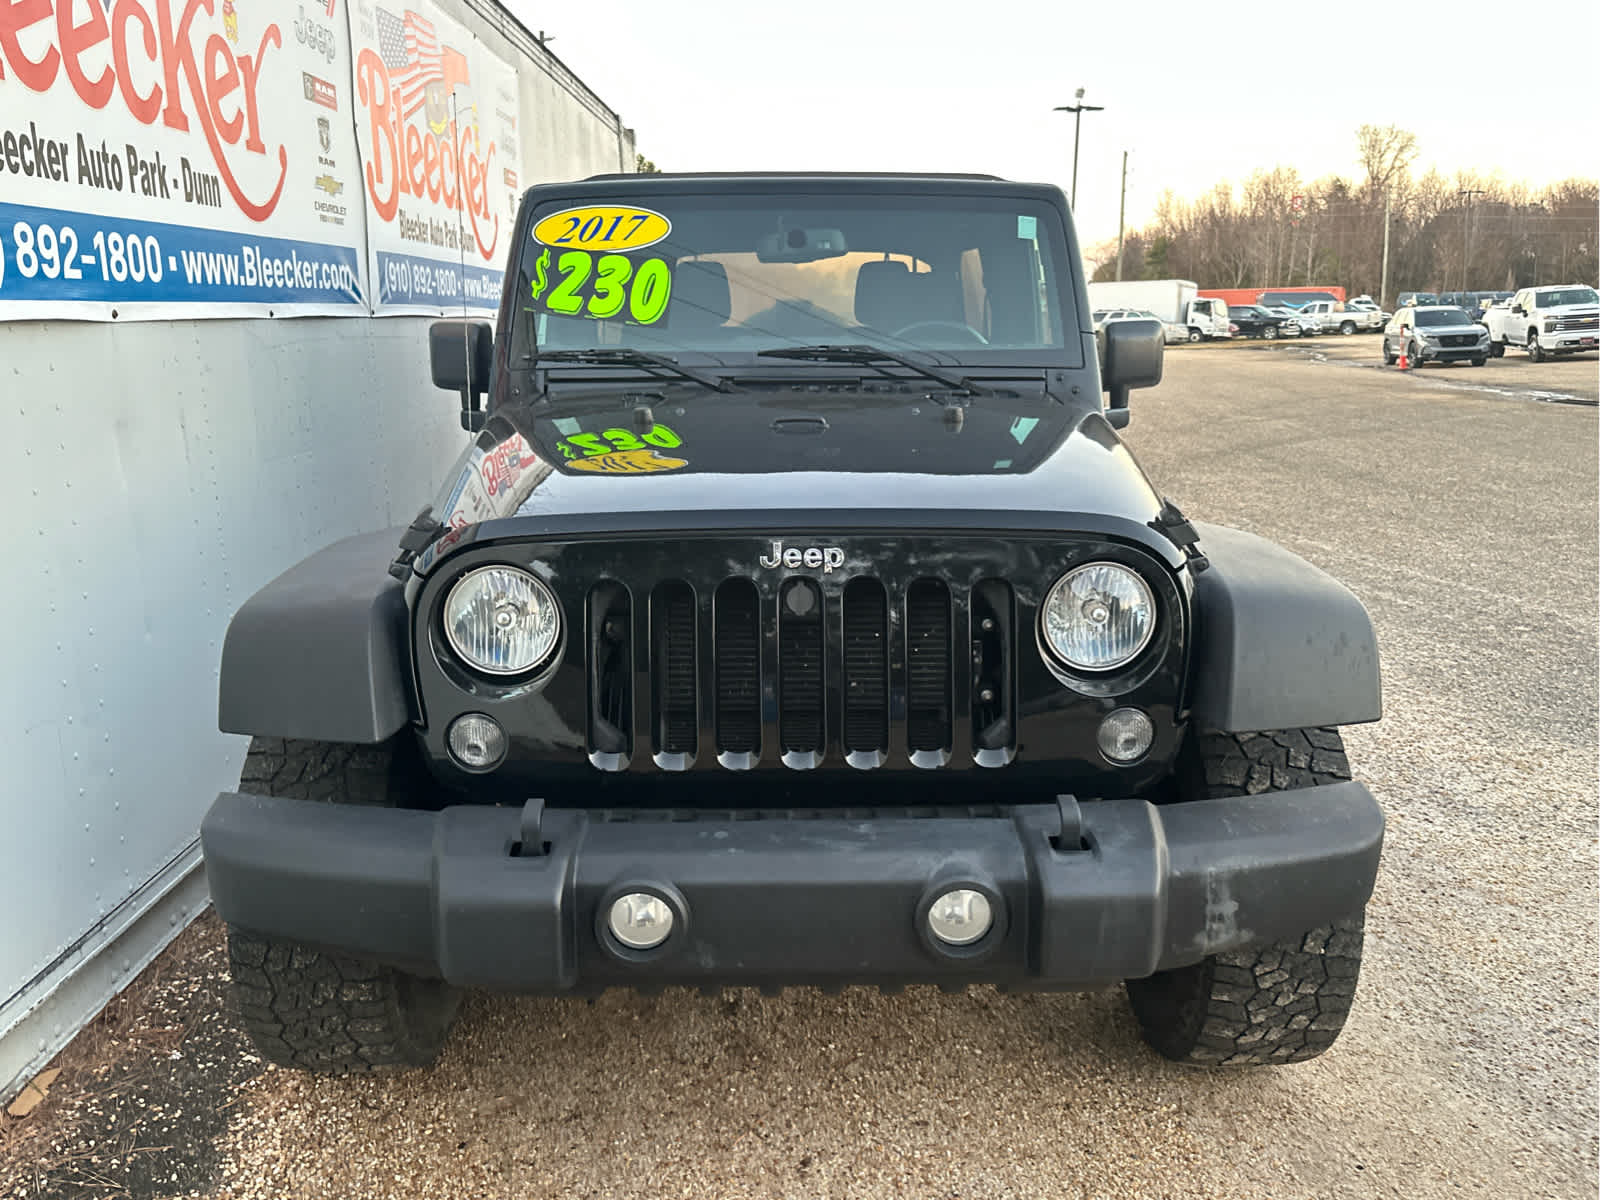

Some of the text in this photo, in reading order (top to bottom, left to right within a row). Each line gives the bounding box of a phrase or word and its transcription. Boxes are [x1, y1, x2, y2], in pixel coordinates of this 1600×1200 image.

[294, 5, 336, 64] Jeep
[0, 0, 288, 222] eecker
[0, 121, 222, 208] ecker Auto Park Dunn
[357, 48, 498, 261] Bleecker
[13, 221, 163, 284] 892-1800
[181, 246, 352, 292] www.Bleecker.com
[399, 208, 429, 244] Bleecker
[430, 217, 444, 247] Auto
[444, 220, 459, 250] Park
[554, 215, 650, 243] 2017
[385, 257, 413, 299] (910)
[413, 265, 457, 297] 892-1800
[531, 248, 671, 325] $230
[760, 541, 844, 574] Jeep
